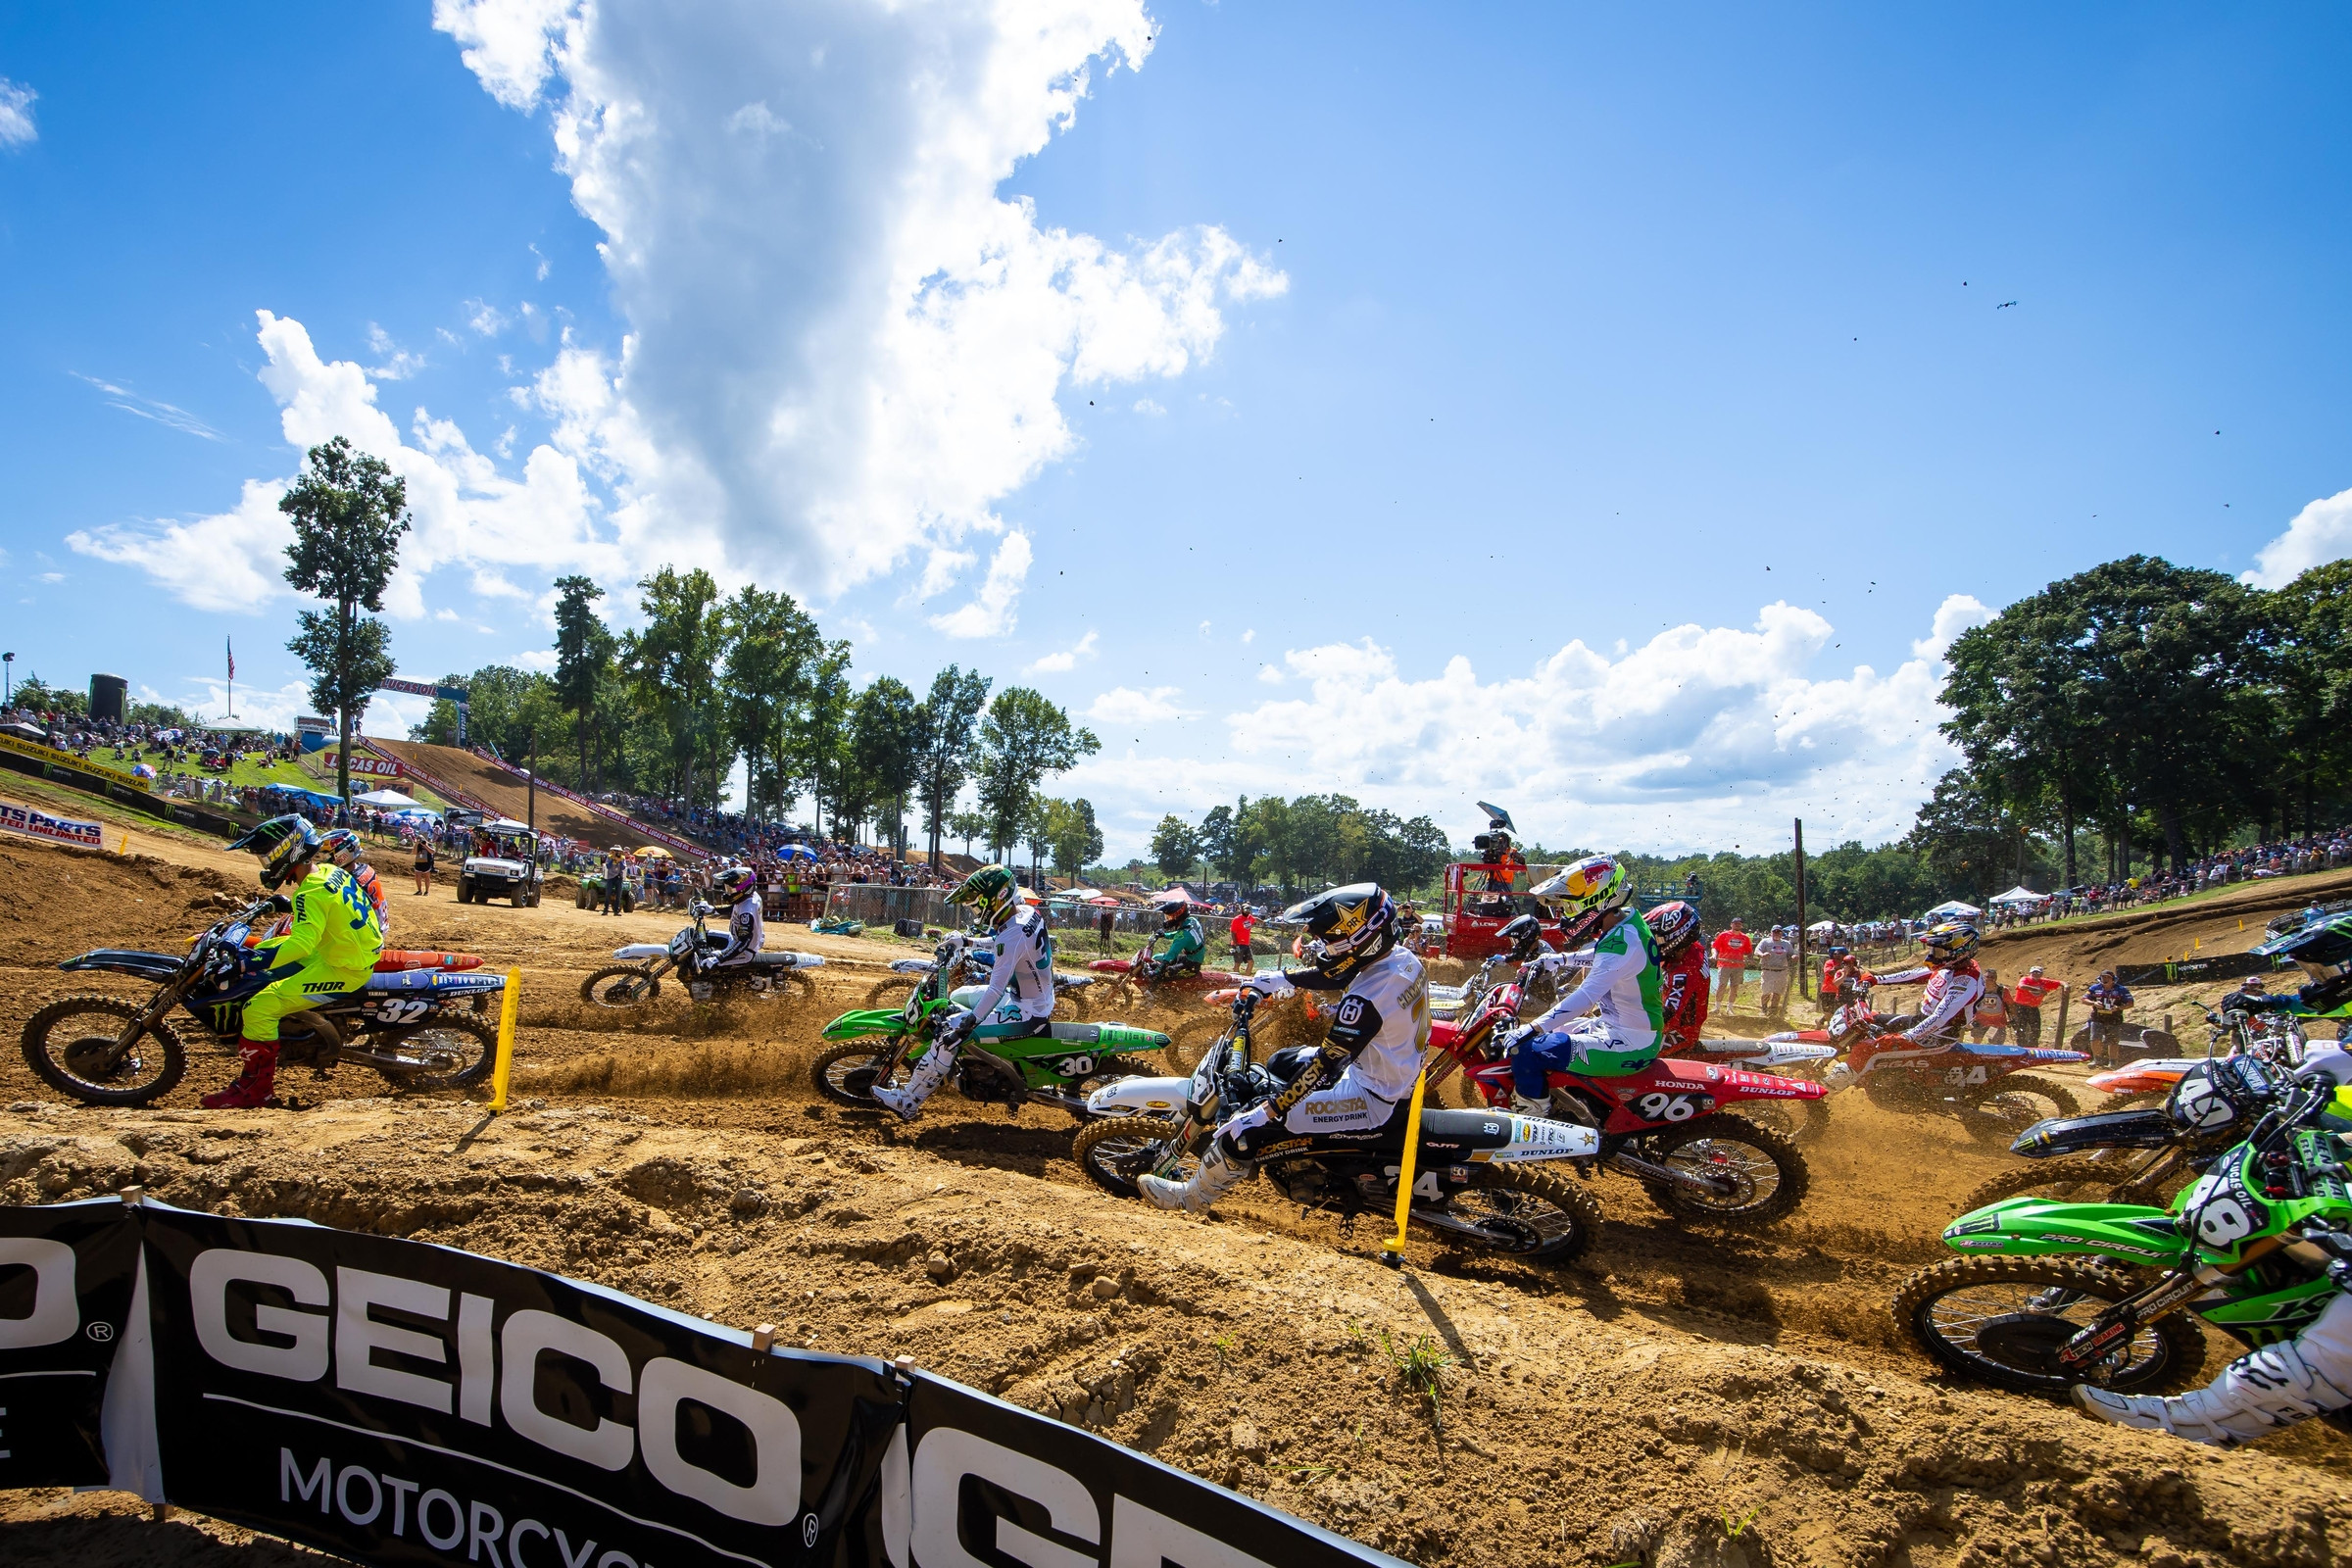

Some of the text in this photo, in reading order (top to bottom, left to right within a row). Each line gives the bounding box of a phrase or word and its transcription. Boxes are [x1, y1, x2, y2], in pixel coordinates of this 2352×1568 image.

[380, 678, 438, 696] LUCAS OIL
[17, 742, 49, 758] SUZUKI
[50, 753, 82, 768] SUZUKI
[83, 763, 116, 779] SUZUKI
[118, 775, 148, 790] SUZUKI
[329, 756, 373, 773] LCAS
[376, 760, 398, 775] OIL
[27, 824, 101, 846] UNLIMITED
[29, 812, 101, 838] PARTS
[268, 833, 301, 862] 100%
[1582, 878, 1619, 908] 100%
[302, 981, 346, 994] THOR
[449, 987, 491, 998] DUNLOP
[751, 976, 772, 991] 31
[376, 998, 428, 1024] 32
[1058, 1055, 1094, 1077] 30
[1654, 1079, 1706, 1091] HONDA
[1740, 1085, 1796, 1097] DUNLOP
[2221, 1087, 2232, 1097] OIL
[1639, 1092, 1694, 1122] 96
[1312, 1111, 1368, 1124] ENERGY DRINK
[1523, 1115, 1576, 1129] DUNLOP
[1255, 1146, 1309, 1162] ENERGY DRINK
[1425, 1141, 1460, 1150] GUTS
[1520, 1148, 1574, 1157] DUNLOP
[1451, 1166, 1467, 1177] 50
[2229, 1161, 2253, 1208] LUCAS OIL
[2039, 1233, 2177, 1259] PRO CIRCUIT
[2135, 1280, 2195, 1320] PRO CIRCUIT
[2091, 1323, 2127, 1347] BRAKING
[189, 1248, 803, 1527] GEICO
[278, 1446, 655, 1568] MOTORCY
